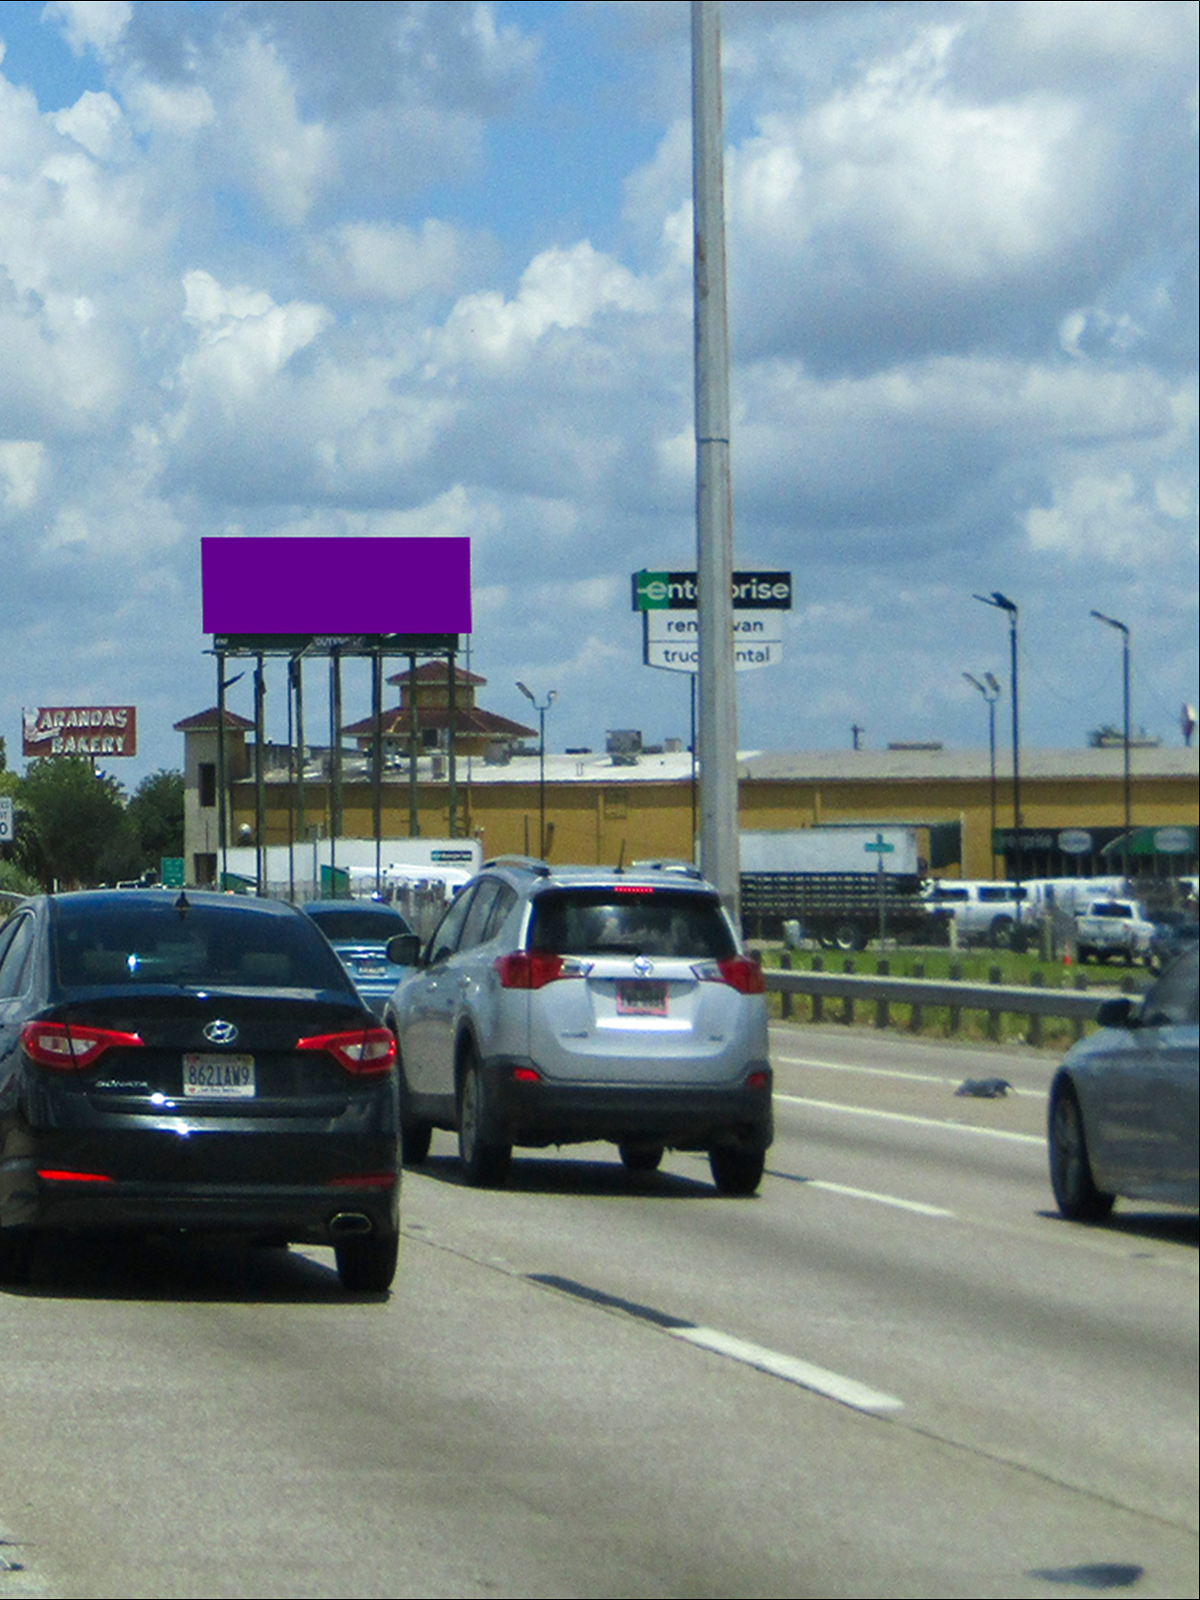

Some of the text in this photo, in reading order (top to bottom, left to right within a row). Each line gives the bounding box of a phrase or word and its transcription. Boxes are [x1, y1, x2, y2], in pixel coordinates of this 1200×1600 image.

[646, 578, 789, 601] entrise
[667, 620, 764, 632] ren van
[663, 646, 770, 662] truc ntal
[40, 709, 128, 729] ARANDAS
[51, 735, 126, 754] BAKERY
